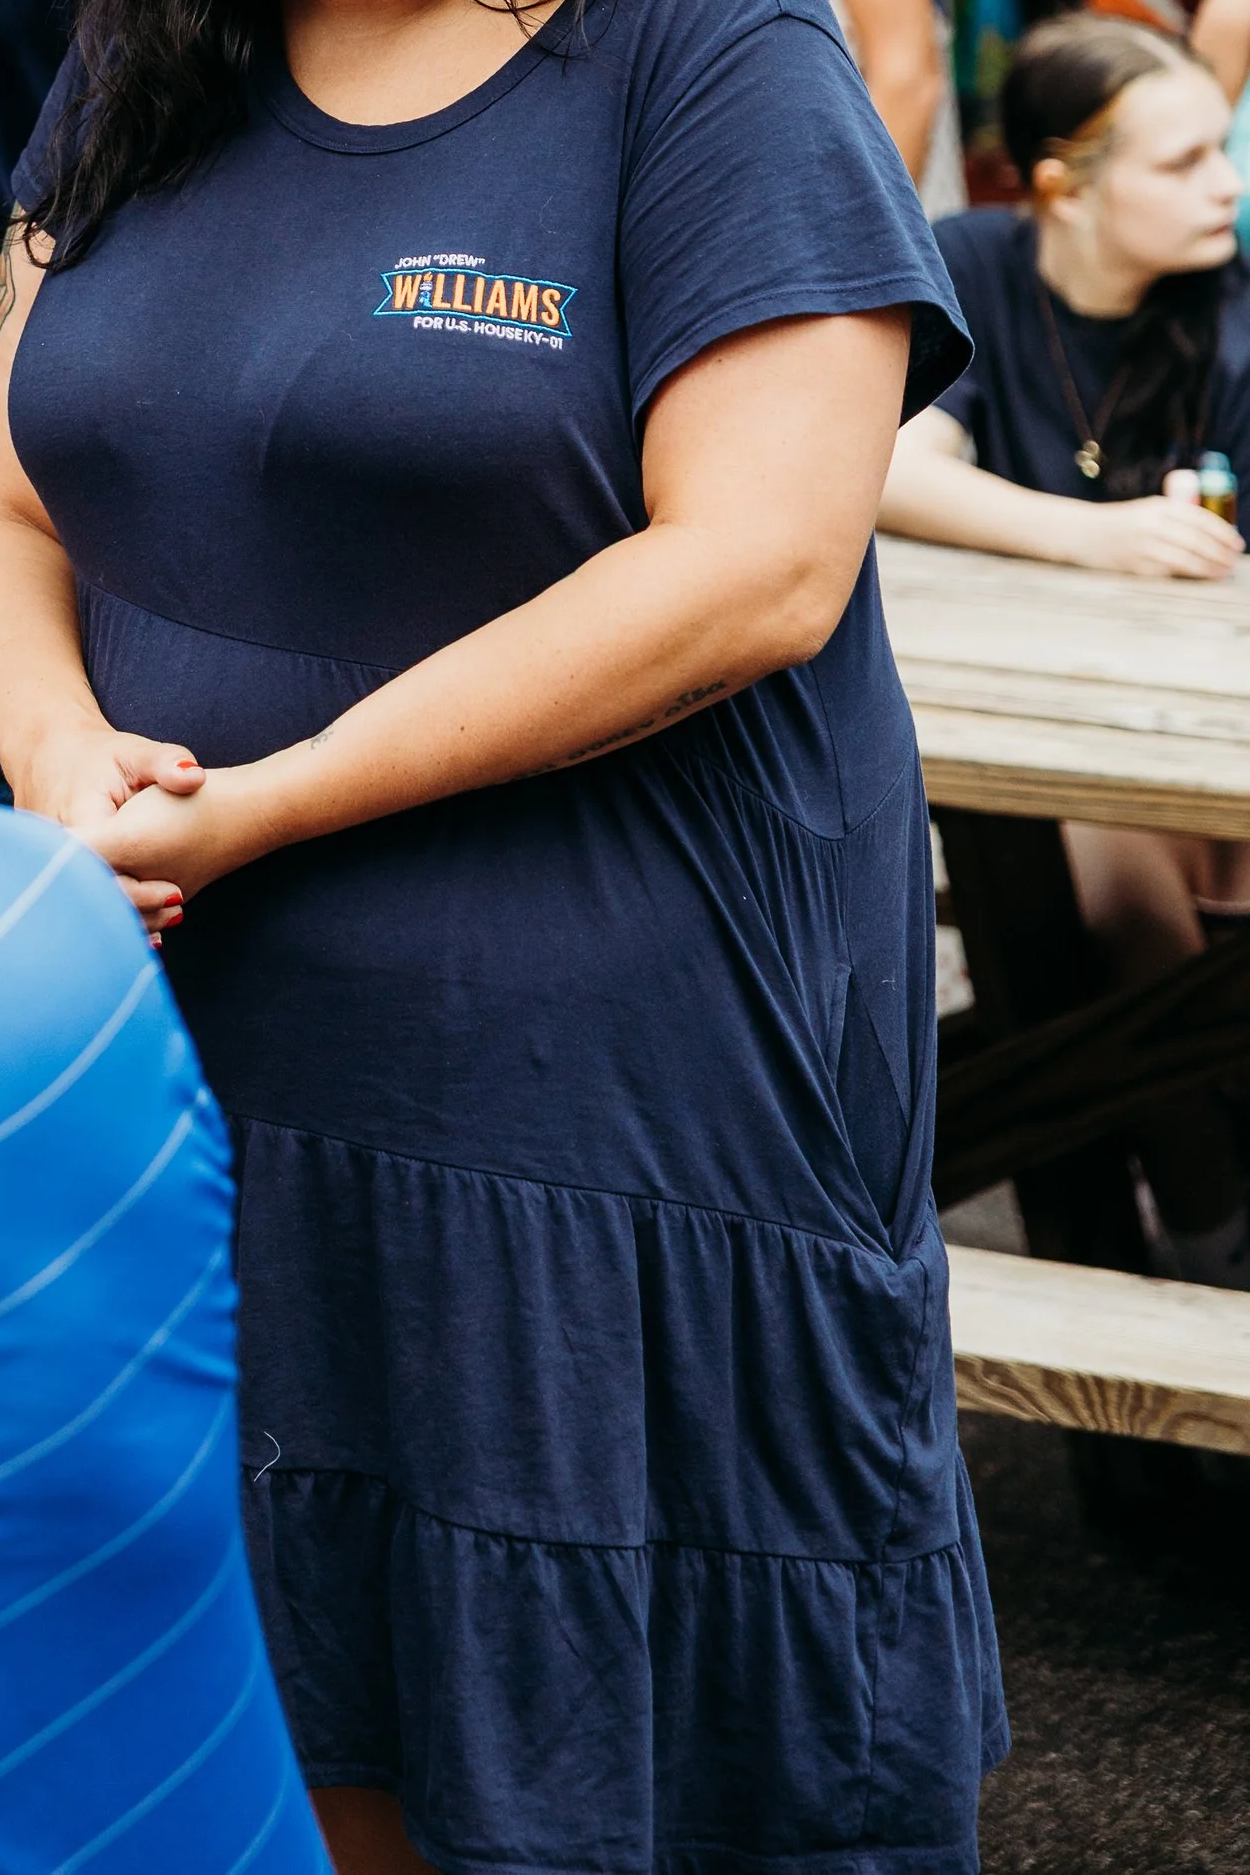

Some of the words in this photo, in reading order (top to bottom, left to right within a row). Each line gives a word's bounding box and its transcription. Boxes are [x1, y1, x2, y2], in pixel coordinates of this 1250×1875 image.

[395, 255, 431, 269] JOHN
[393, 272, 561, 325] WILLIAMS
[413, 316, 442, 330] FOR
[445, 317, 472, 332] U.S.
[474, 321, 523, 341] HOUSE
[524, 329, 563, 350] KY-01
